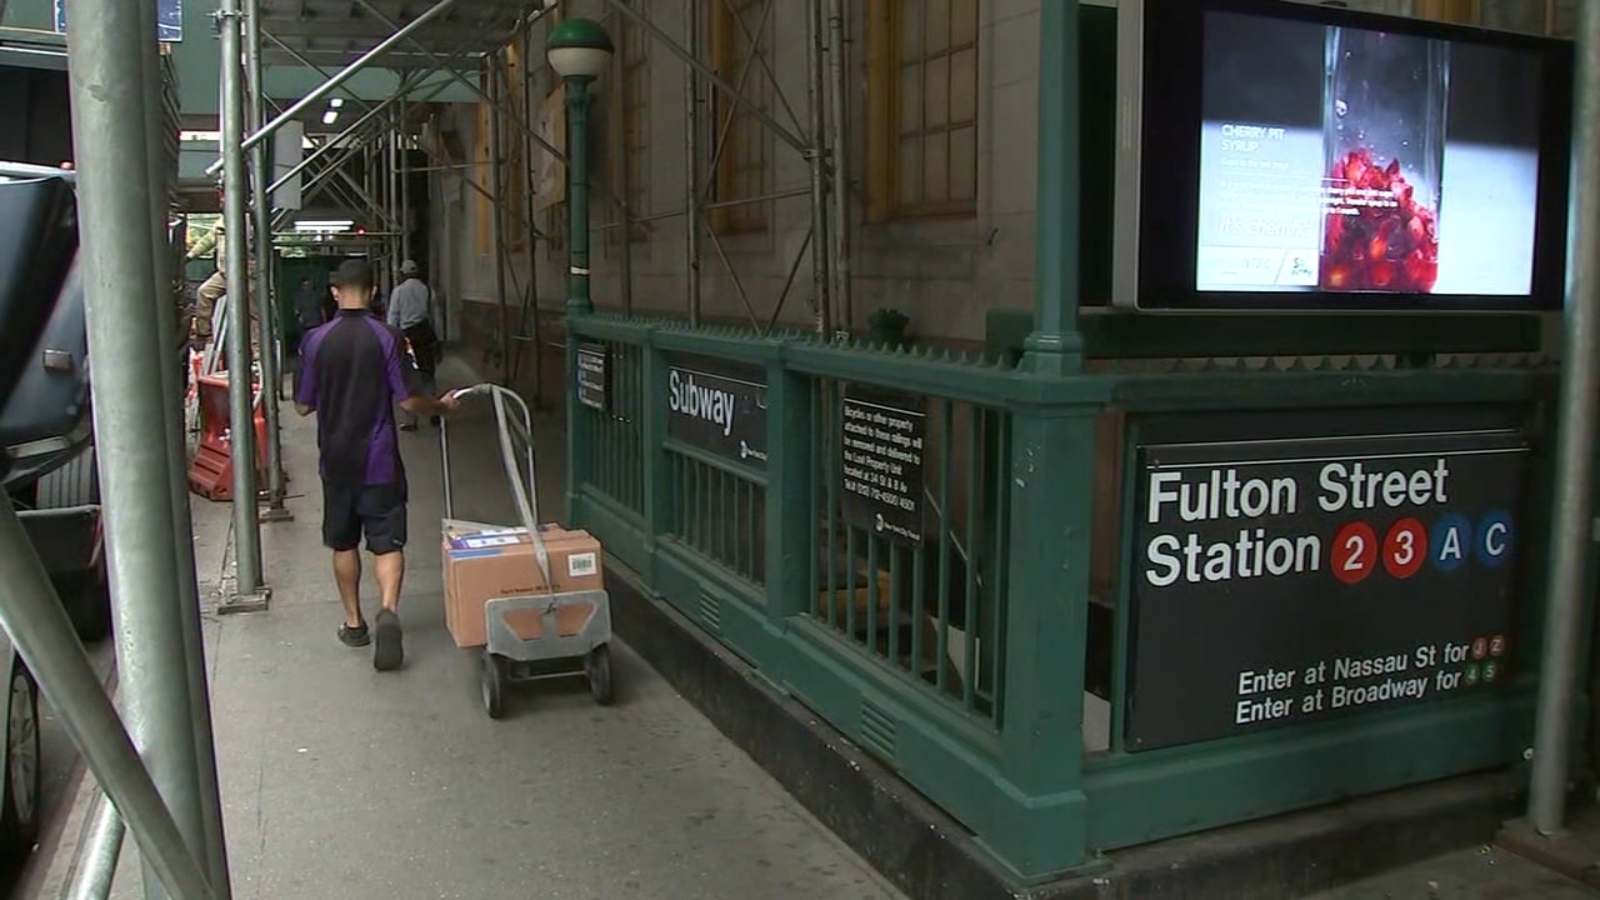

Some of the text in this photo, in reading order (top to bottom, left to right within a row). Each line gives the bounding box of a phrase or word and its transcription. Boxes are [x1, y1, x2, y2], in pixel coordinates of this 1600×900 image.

[1221, 124, 1286, 141] CHERRY PIT
[1221, 140, 1259, 152] SYRUP
[669, 369, 735, 436] Subway
[844, 406, 865, 420] Bicycles
[873, 413, 887, 425] other
[888, 418, 913, 433] property
[844, 422, 923, 449] attached to these railings will
[844, 435, 921, 465] be removed and delivered to
[844, 450, 852, 461] the
[853, 452, 865, 464] Lost
[866, 455, 889, 474] Property
[844, 464, 862, 479] located
[870, 471, 879, 483] 34
[1148, 459, 1449, 523] Fulton Street
[1146, 522, 1507, 587] Station 2 3 A C
[1238, 669, 1296, 695] Enter
[1304, 661, 1326, 686] at
[1334, 652, 1409, 680] Nassau
[1415, 645, 1437, 668] St
[1444, 642, 1470, 665] for
[1235, 698, 1293, 724] Enter
[1301, 690, 1324, 714] at
[1331, 675, 1429, 708] Broadway
[1436, 669, 1463, 691] for
